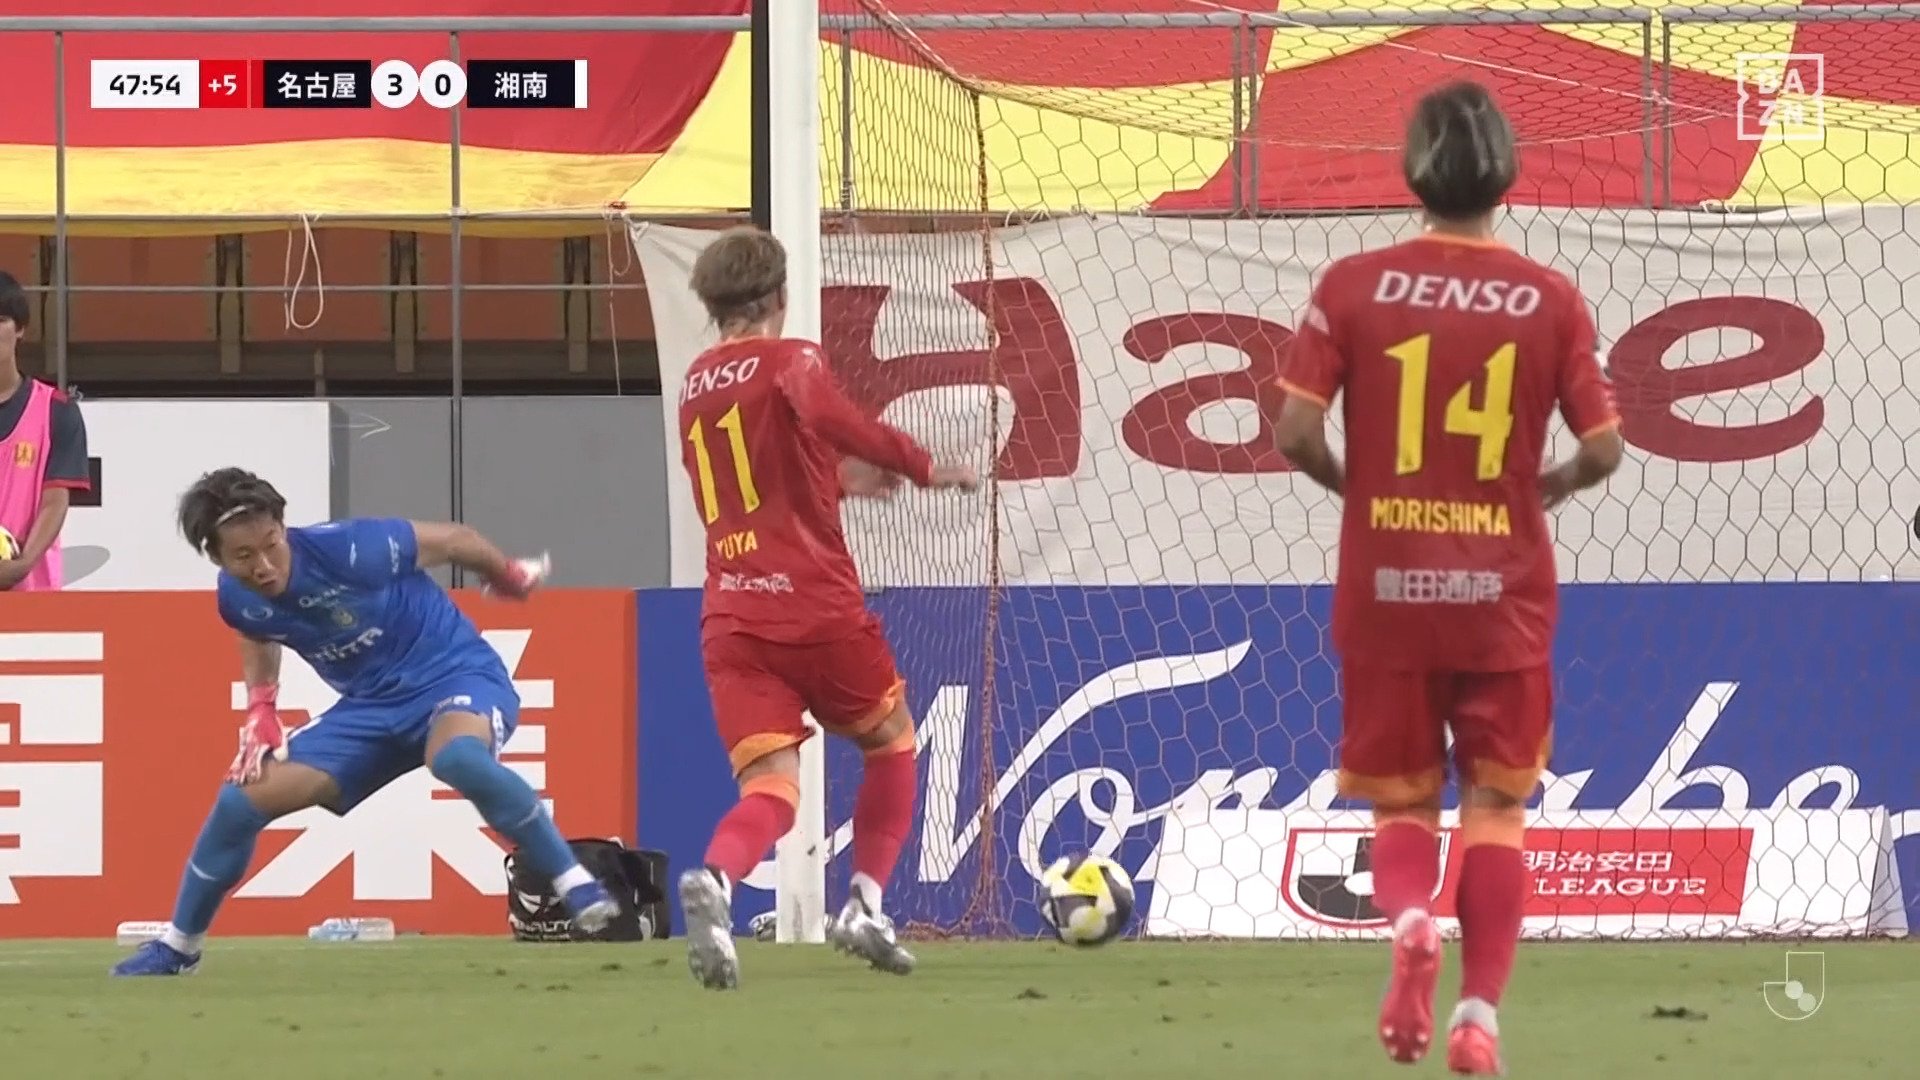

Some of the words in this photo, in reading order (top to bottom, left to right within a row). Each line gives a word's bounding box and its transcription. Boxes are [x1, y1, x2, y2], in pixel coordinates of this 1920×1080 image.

[1374, 269, 1541, 317] DENSO
[822, 276, 1825, 480] Hae
[1383, 333, 1518, 481] 14
[687, 401, 761, 526] 11
[715, 528, 758, 561] YUYA
[1370, 496, 1512, 536] MORISHIMA
